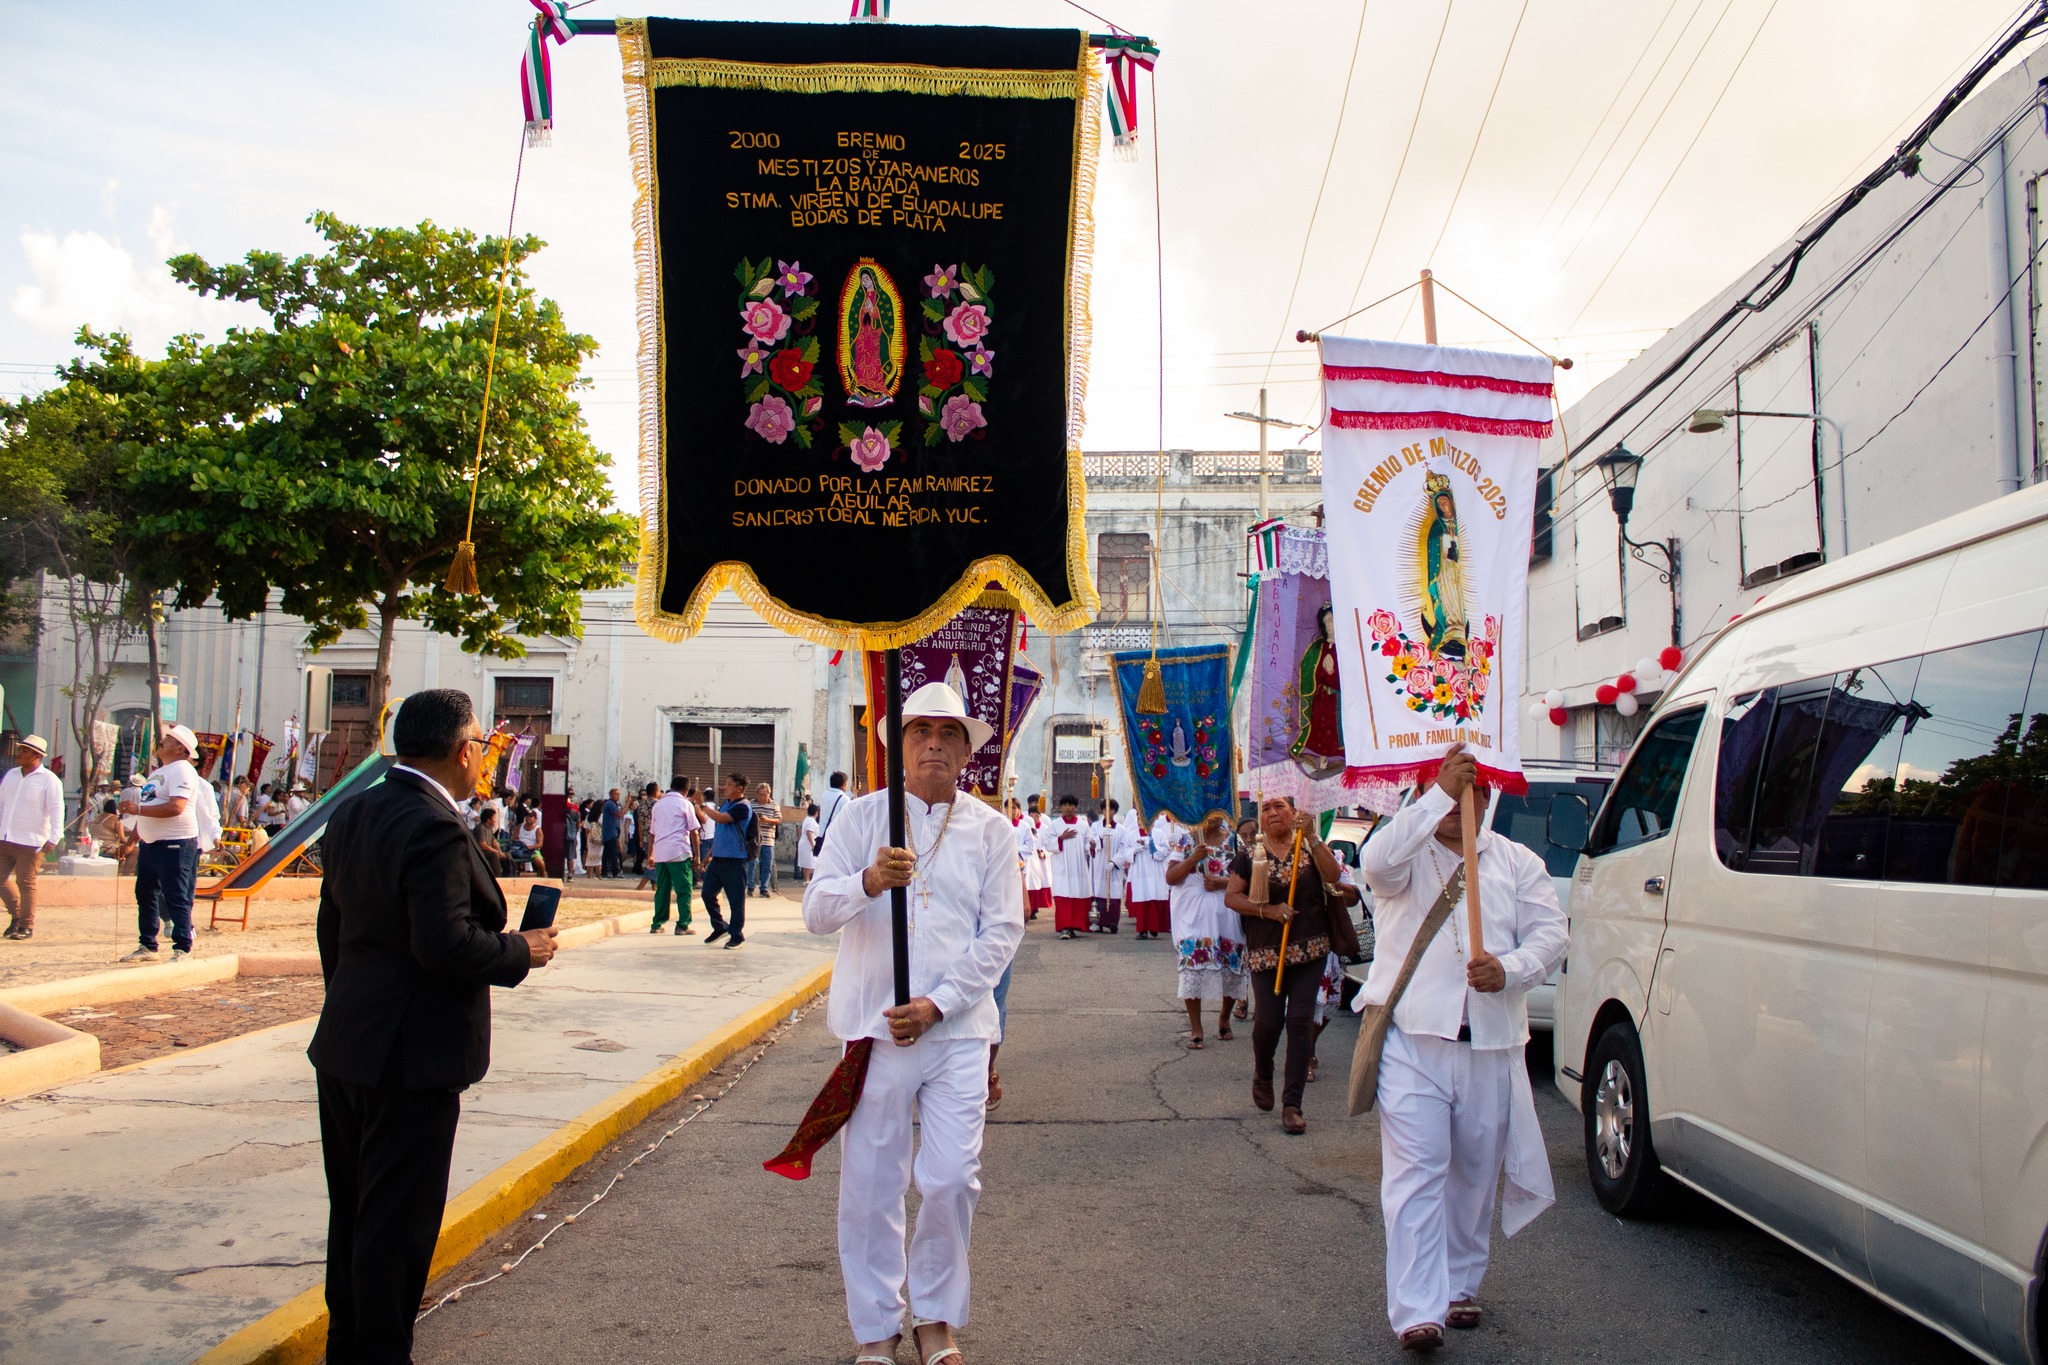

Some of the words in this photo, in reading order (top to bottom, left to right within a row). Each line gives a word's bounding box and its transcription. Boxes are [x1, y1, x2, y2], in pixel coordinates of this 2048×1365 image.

[728, 131, 780, 149] 2000
[837, 132, 906, 151] GREMIO
[862, 149, 880, 159] DE
[959, 142, 1006, 160] 2025
[758, 158, 861, 176] MESTIZOS
[878, 160, 980, 186] JARANEROS
[815, 175, 842, 192] LA
[849, 175, 920, 196] BAJADA
[726, 192, 782, 209] STMA.
[790, 191, 859, 210] VIRGEN
[867, 192, 893, 209] DE
[902, 194, 1004, 220] GUADALUPE
[791, 208, 849, 227] BODAS
[858, 209, 882, 226] DE
[892, 210, 946, 232] PLATA
[734, 477, 811, 496] DONADO
[819, 474, 852, 492] POR
[856, 478, 882, 494] LA
[926, 474, 994, 492] RAMIREZ
[1353, 454, 1403, 514] GREMIO
[1401, 442, 1426, 466] DE
[1476, 477, 1507, 520] 2025
[830, 493, 912, 511] AGUILAR
[946, 506, 988, 524] YUC.
[951, 620, 964, 630] DE
[1388, 731, 1422, 749] PROM.
[1426, 727, 1467, 745] FAMILIA
